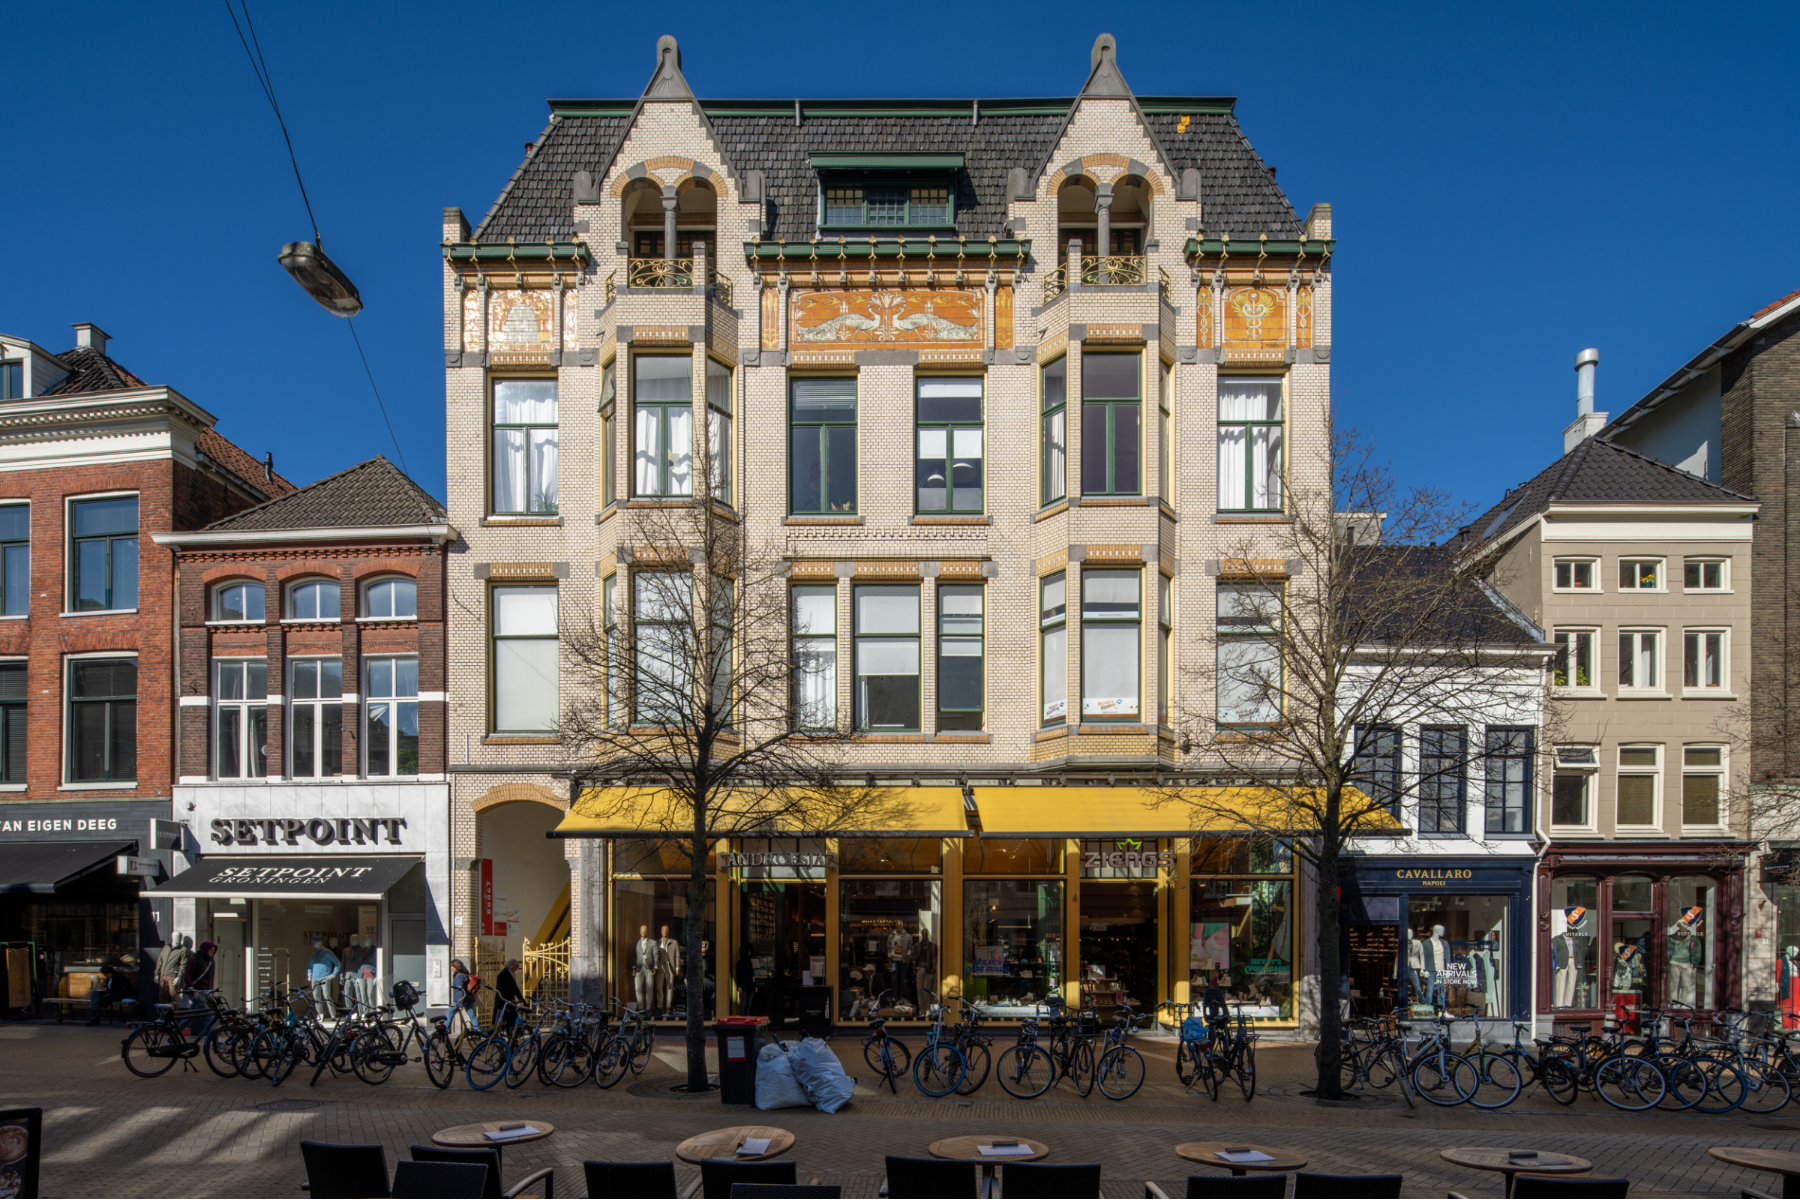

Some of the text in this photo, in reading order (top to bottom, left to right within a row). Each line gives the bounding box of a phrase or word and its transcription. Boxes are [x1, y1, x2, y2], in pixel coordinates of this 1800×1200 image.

[27, 820, 72, 832] EIGEN
[77, 818, 117, 830] DEEG
[210, 817, 407, 844] SETPOINT
[727, 852, 826, 870] ANDROESJA
[1084, 851, 1175, 868] ZIENGS
[217, 866, 372, 878] SETPOINT
[1396, 869, 1472, 879] CAVALLARO
